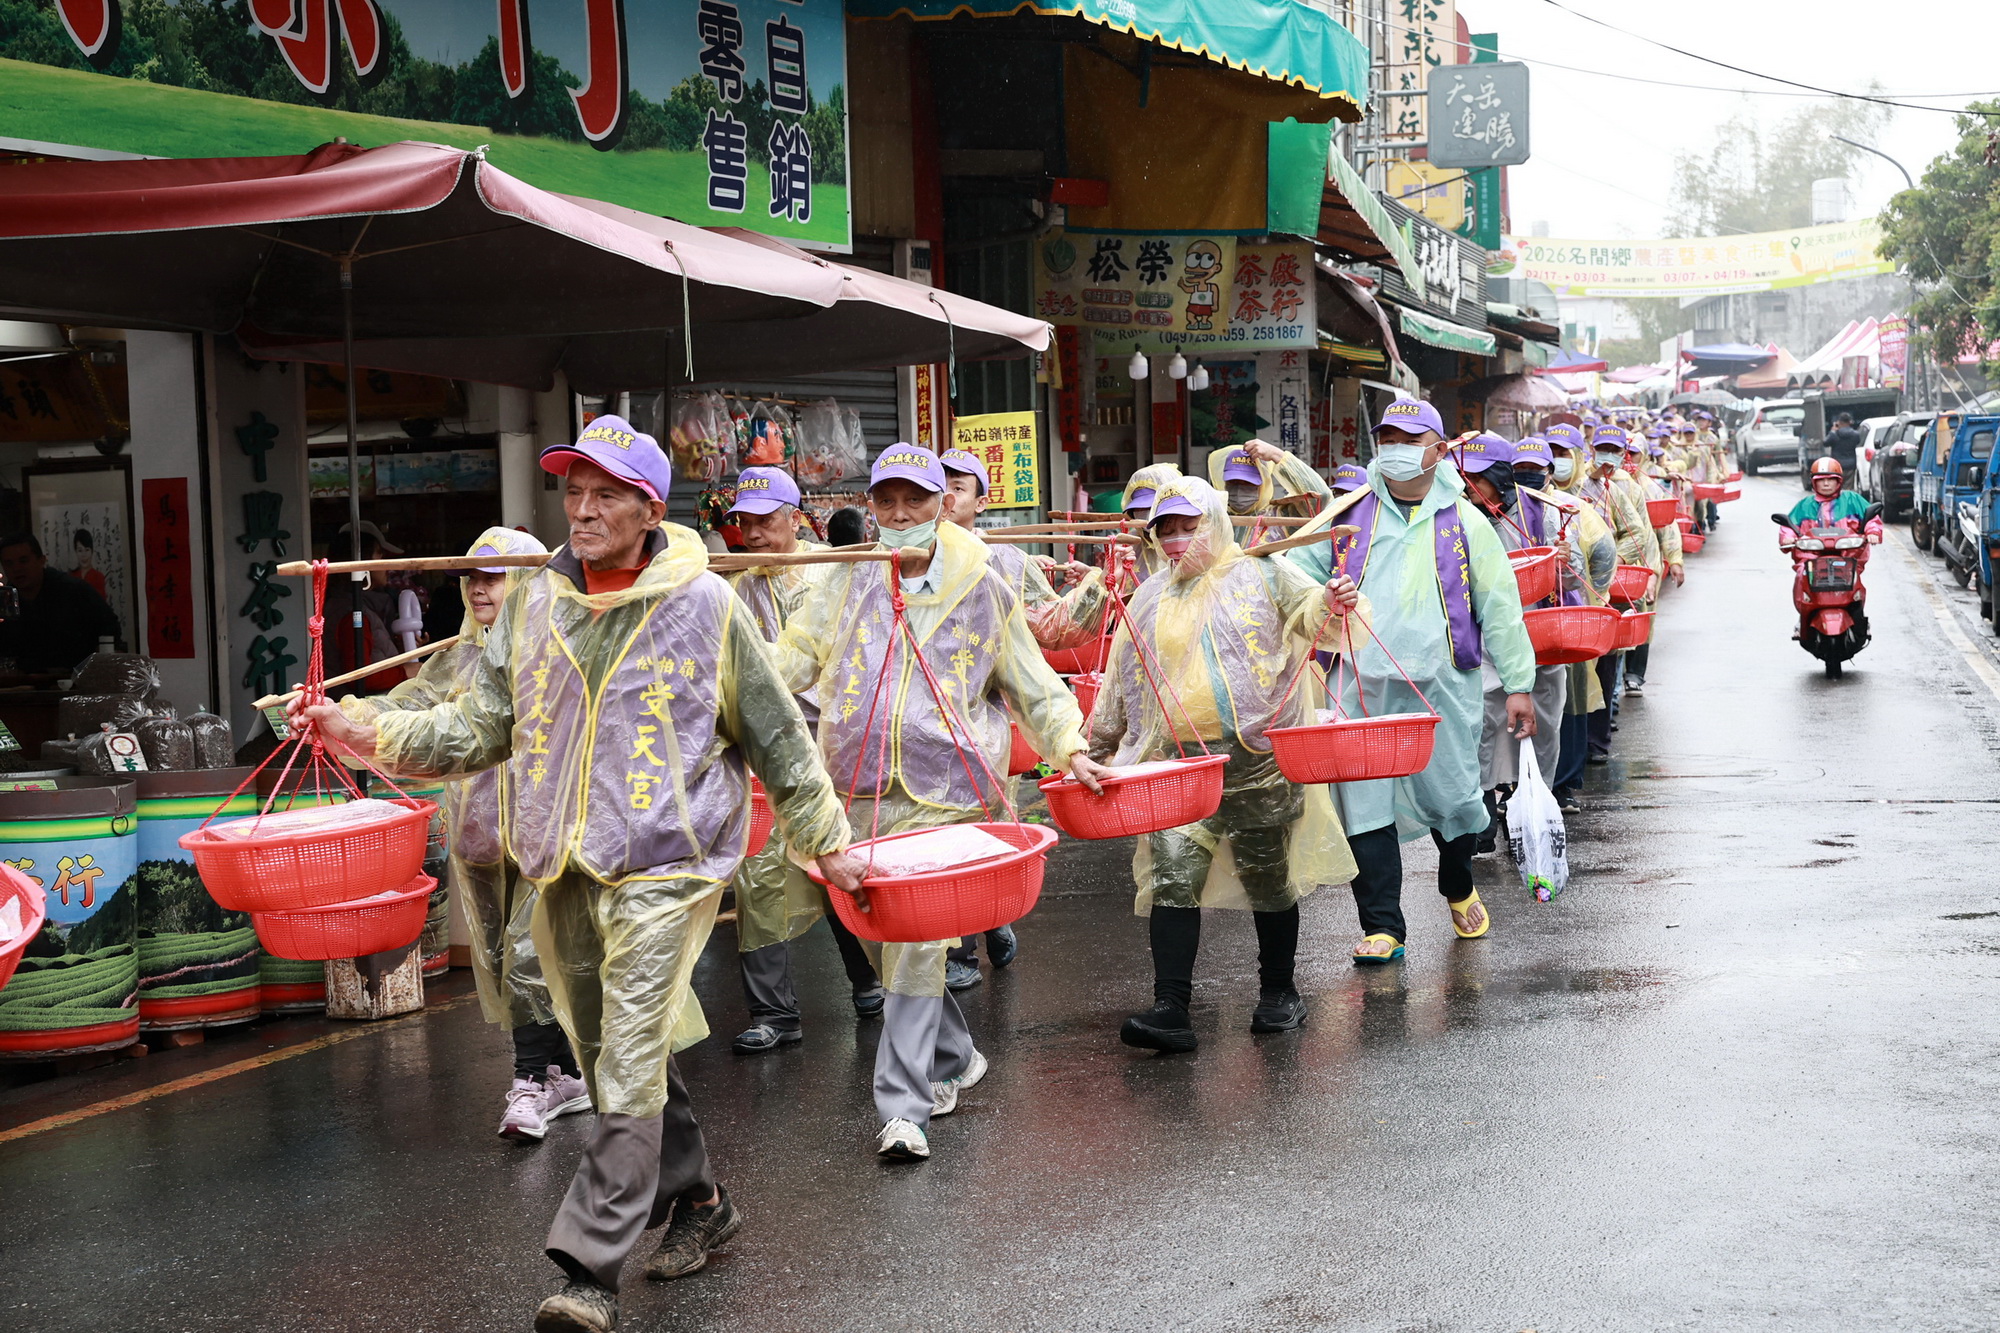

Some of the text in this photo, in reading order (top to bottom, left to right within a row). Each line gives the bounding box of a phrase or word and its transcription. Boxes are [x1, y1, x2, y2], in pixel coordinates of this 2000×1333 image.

[766, 0, 811, 224] 自銷
[1234, 288, 1304, 322] 茶行
[1252, 325, 1304, 341] 2581867
[957, 424, 1032, 443] 松柏嶺特產
[1012, 441, 1032, 452] 童玩
[1279, 395, 1299, 455] 各種
[984, 444, 1006, 504] 番仔豆
[1012, 453, 1034, 503] 布袋戲
[157, 493, 182, 643] 馬上幸福
[636, 655, 696, 680] 松柏嶺
[527, 661, 554, 791] 玄天上帝
[625, 681, 676, 810] 受天宮
